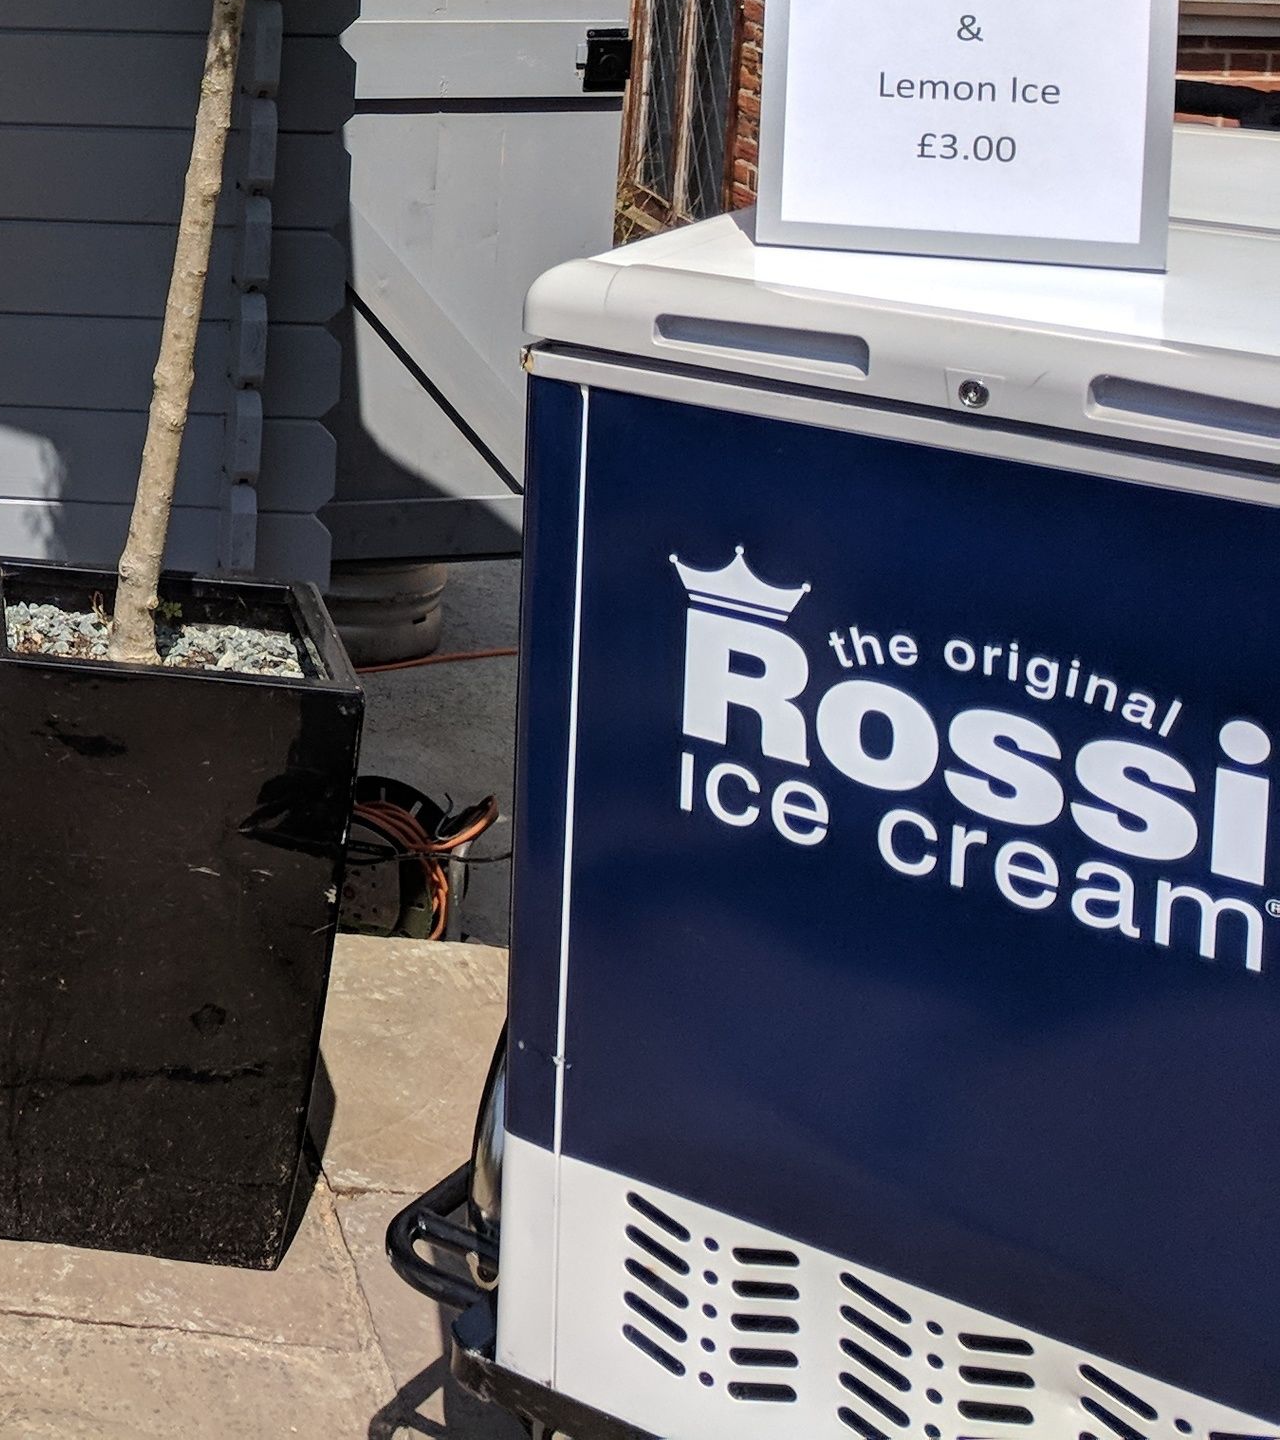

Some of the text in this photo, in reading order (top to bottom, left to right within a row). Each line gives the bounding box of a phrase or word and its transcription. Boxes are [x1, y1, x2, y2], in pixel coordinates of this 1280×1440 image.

[956, 14, 984, 42] &
[879, 71, 1061, 105] Lemon Ice
[916, 132, 1017, 163] £3.00
[828, 626, 1183, 737] the original
[682, 606, 1271, 886] Rossi
